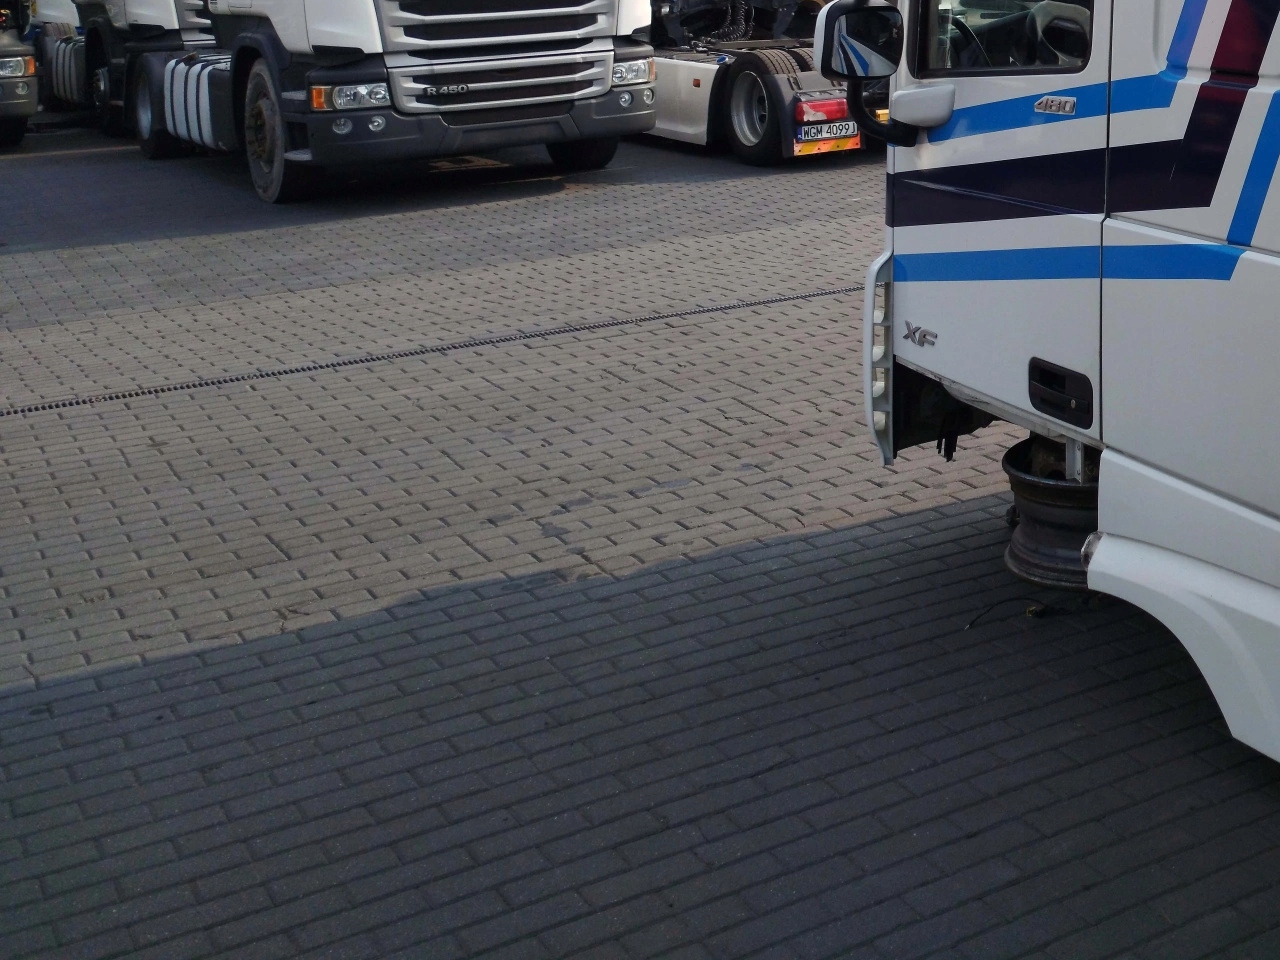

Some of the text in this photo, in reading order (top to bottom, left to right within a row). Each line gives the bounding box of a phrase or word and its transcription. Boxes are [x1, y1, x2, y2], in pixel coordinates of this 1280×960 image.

[427, 83, 468, 96] R 450
[1034, 95, 1077, 116] 480
[803, 126, 823, 139] WGM
[903, 320, 938, 348] XF
